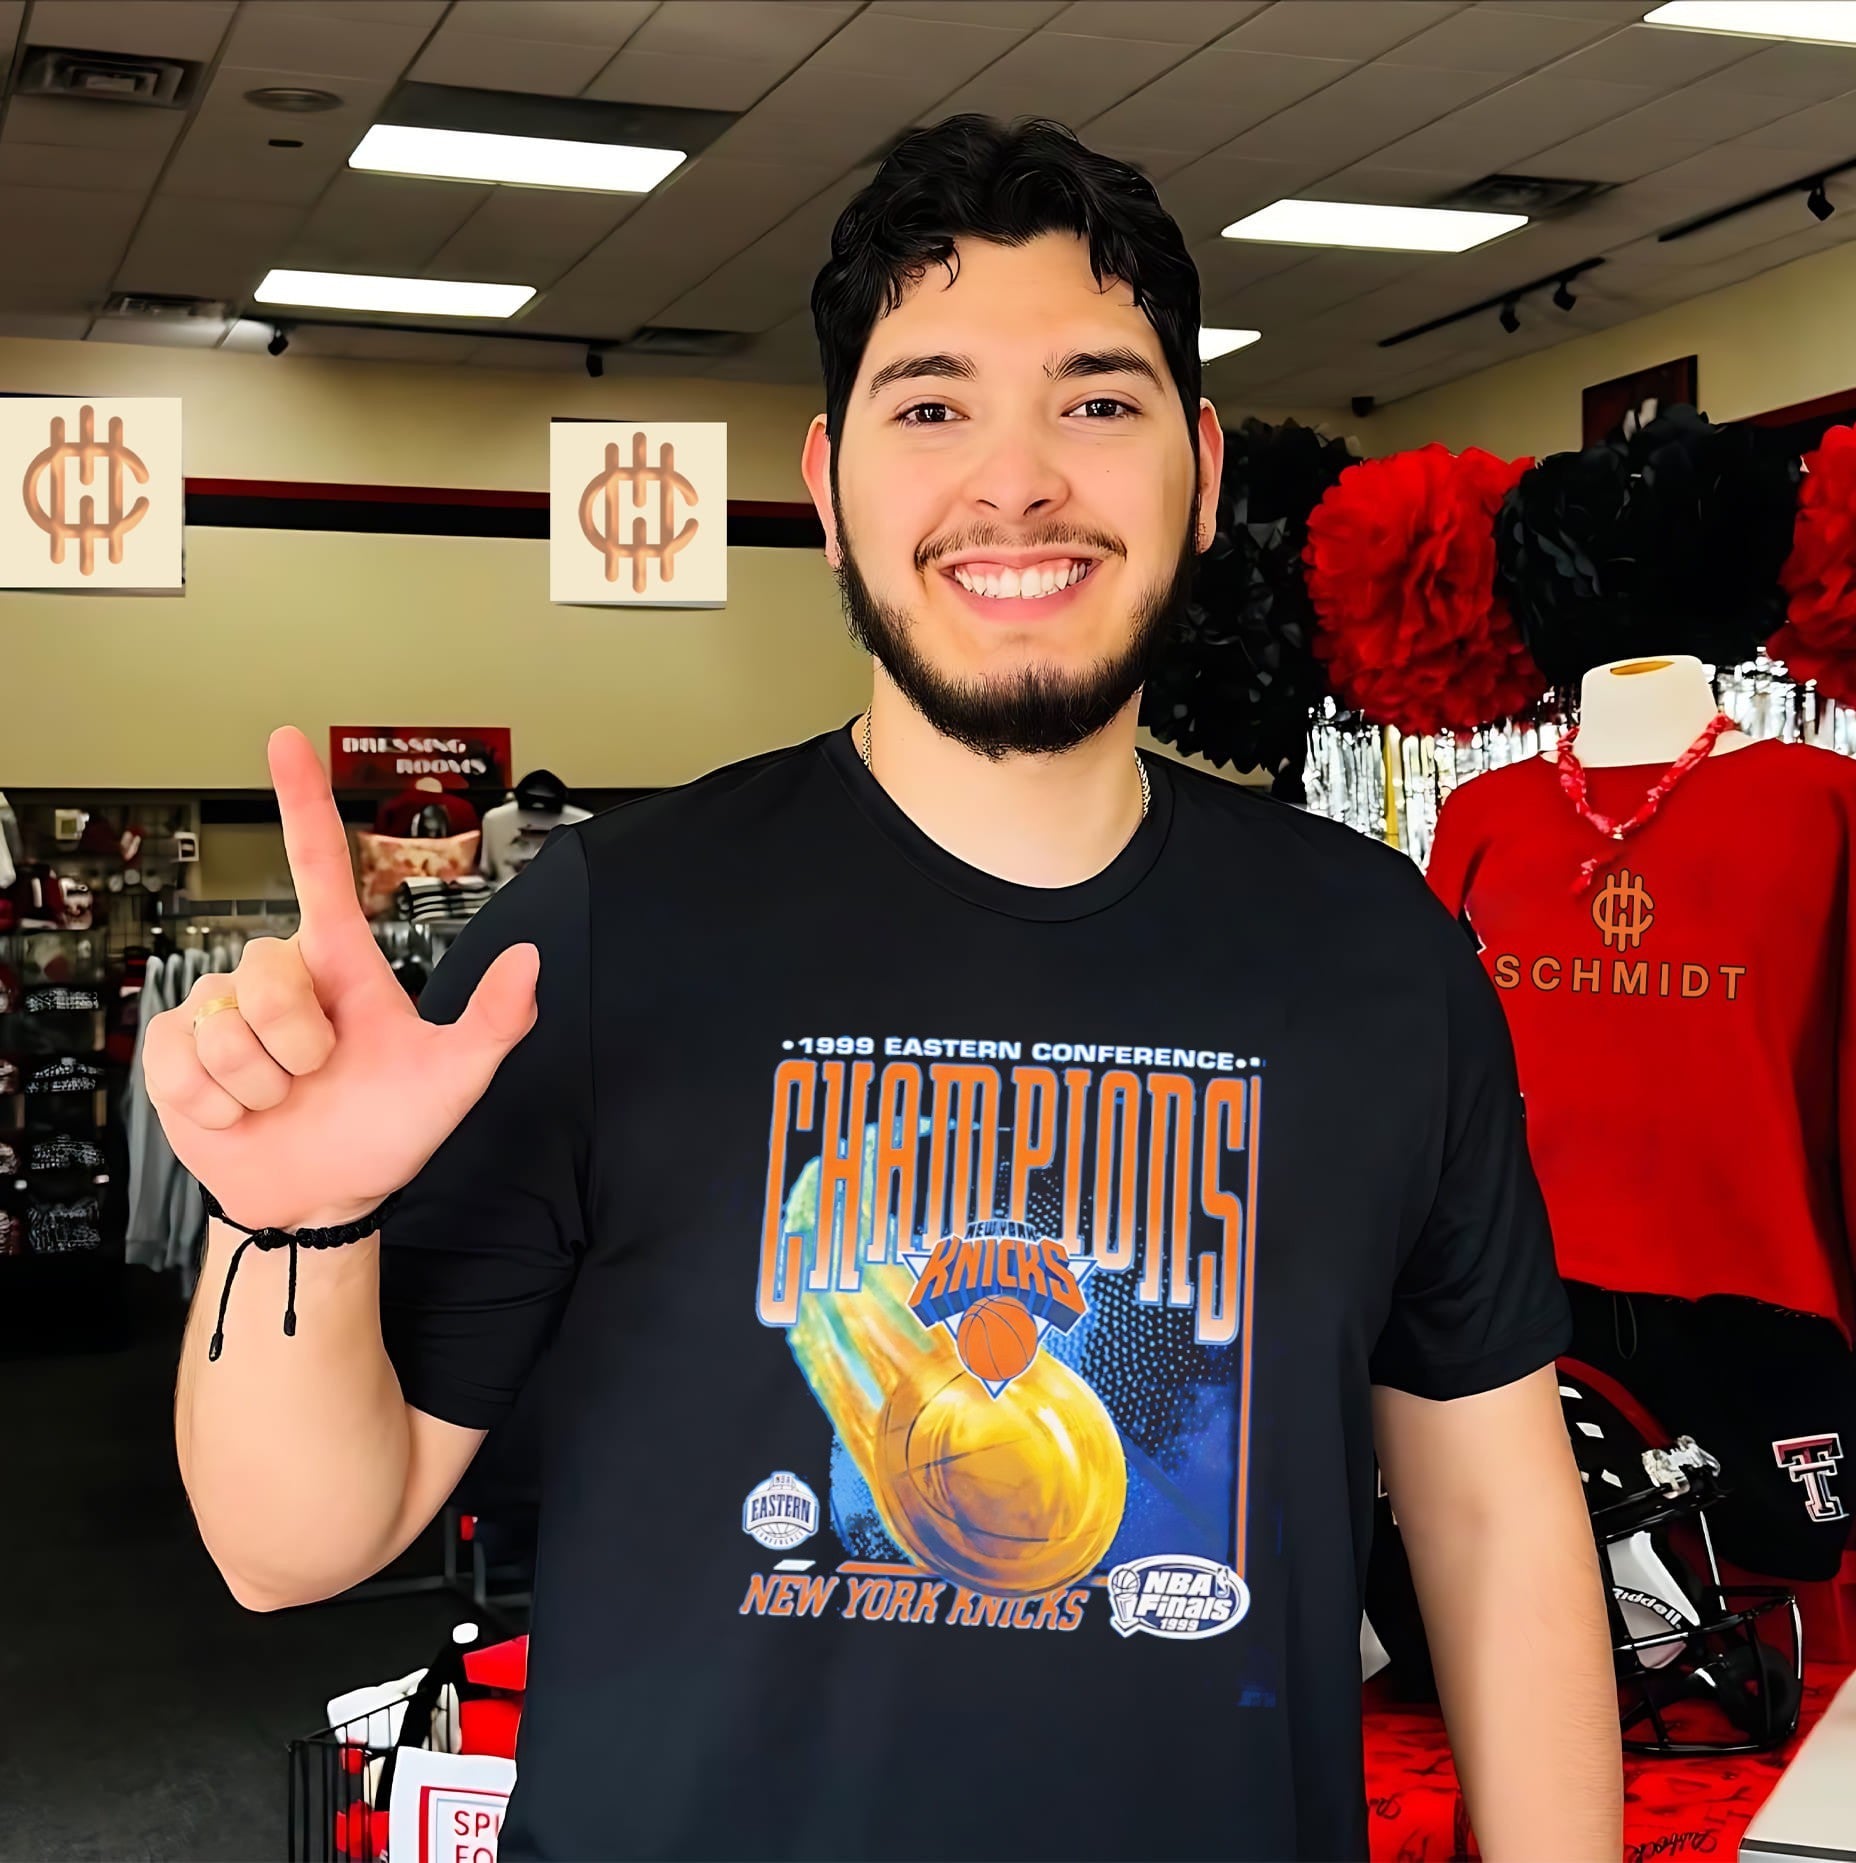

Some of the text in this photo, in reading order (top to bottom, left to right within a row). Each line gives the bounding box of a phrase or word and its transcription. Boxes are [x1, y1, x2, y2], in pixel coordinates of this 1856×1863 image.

[342, 737, 467, 754] DRESSING
[396, 758, 487, 775] ROOMS
[1494, 954, 1747, 1001] SCHMIDT
[798, 1036, 1235, 1071] 1999 EASTERN CONFERENCE
[756, 1059, 1247, 1346] CHAMPIONS
[908, 1235, 1087, 1316] KNICKS
[751, 1493, 812, 1524] EASTERN
[1142, 1570, 1214, 1597] NBA
[739, 1573, 1090, 1632] NEW YORK KNICKS
[1135, 1593, 1233, 1622] Finals
[1160, 1618, 1200, 1632] 1999
